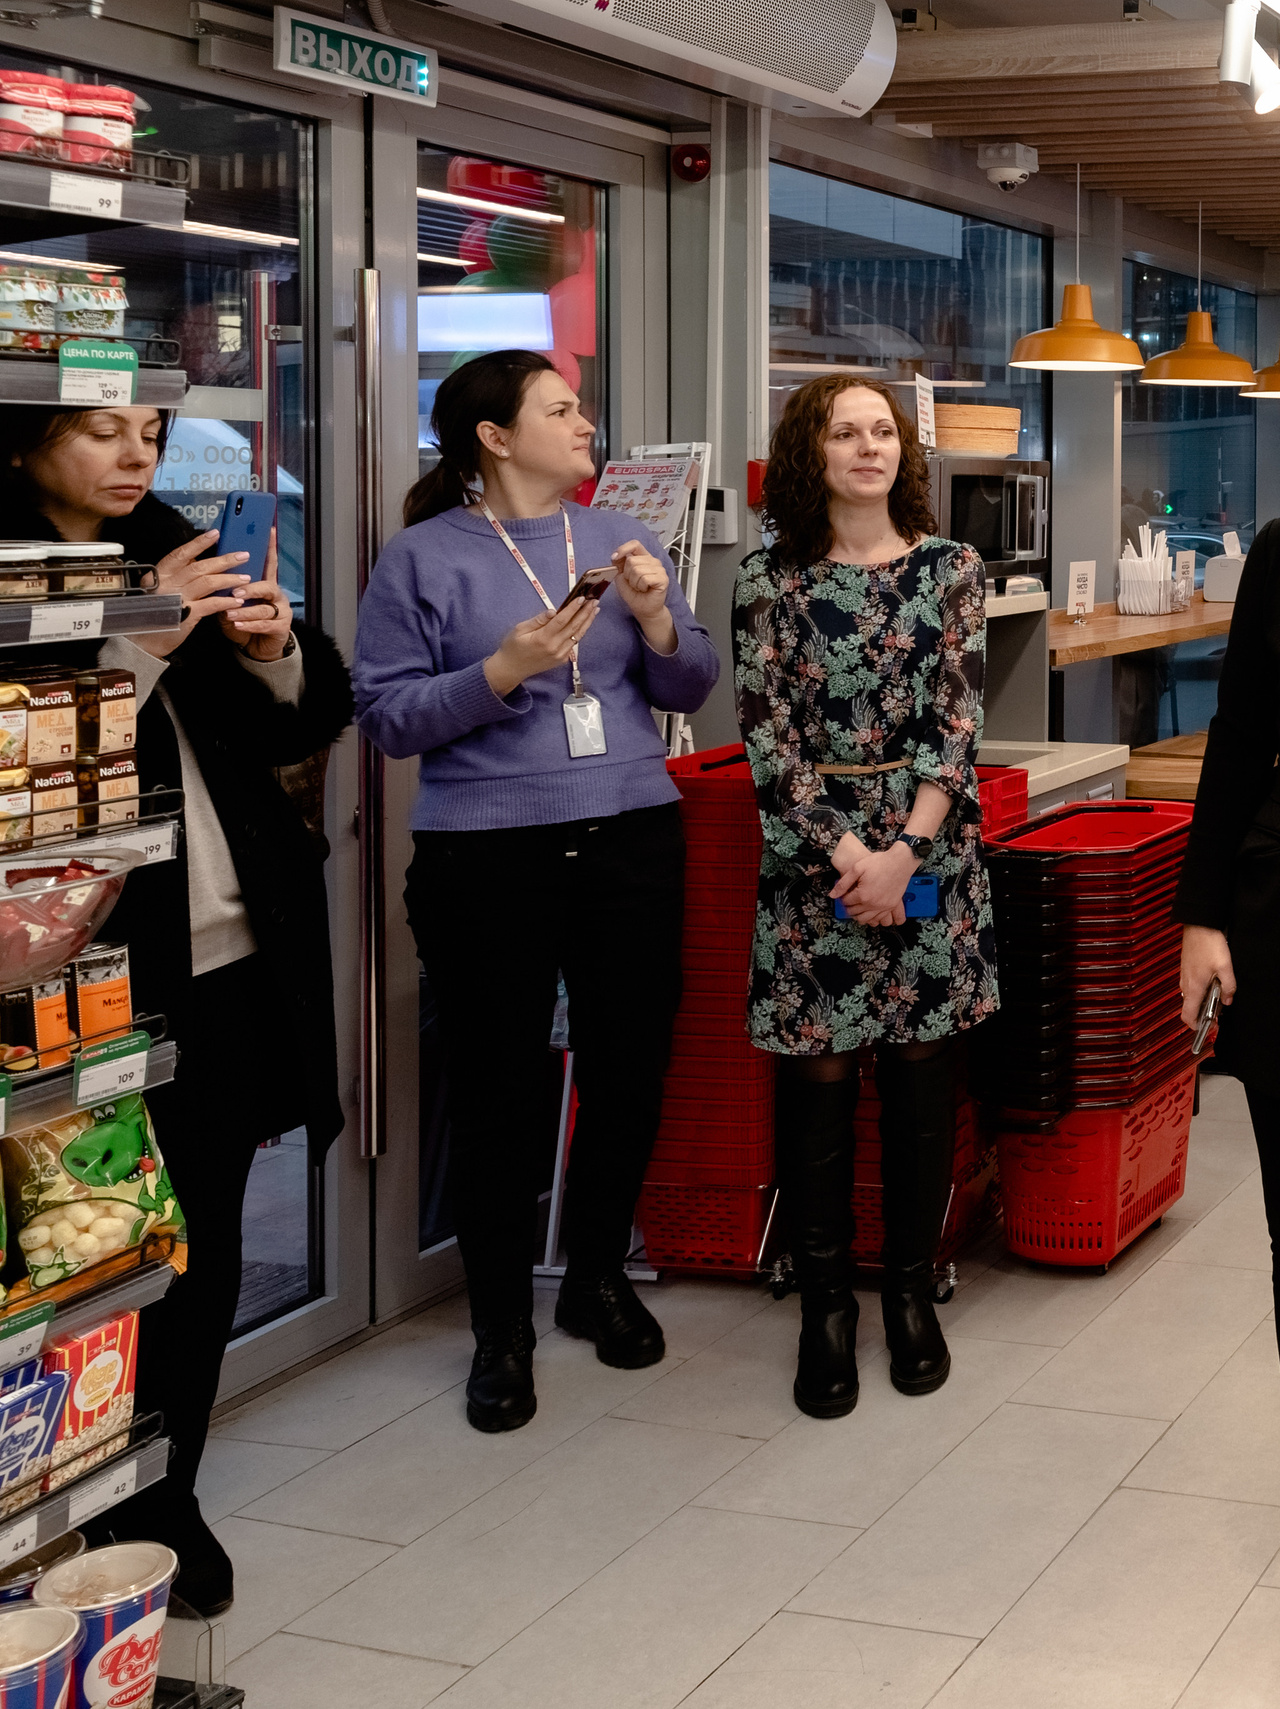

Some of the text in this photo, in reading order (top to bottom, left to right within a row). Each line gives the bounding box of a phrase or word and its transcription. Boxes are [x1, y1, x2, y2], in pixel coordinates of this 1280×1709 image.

[295, 26, 420, 95] ВЫХОД
[98, 199, 112, 208] 99
[63, 348, 134, 360] ЦЕНА ПО КАРТЕ
[101, 390, 118, 399] 109
[614, 465, 676, 474] EUROSPAR
[73, 620, 90, 630] 159
[101, 682, 134, 697] Natural
[30, 693, 73, 707] Natural
[107, 703, 129, 718] МЁД
[36, 712, 67, 728] МЁД
[99, 762, 136, 777] Natural
[35, 773, 75, 788] Natural
[106, 781, 131, 798] МЁД
[41, 793, 69, 809] МЁД
[144, 844, 161, 855] 199
[118, 1072, 134, 1084] 109
[17, 1343, 32, 1356] 39
[113, 1483, 127, 1495] 42
[12, 1539, 27, 1551] 44
